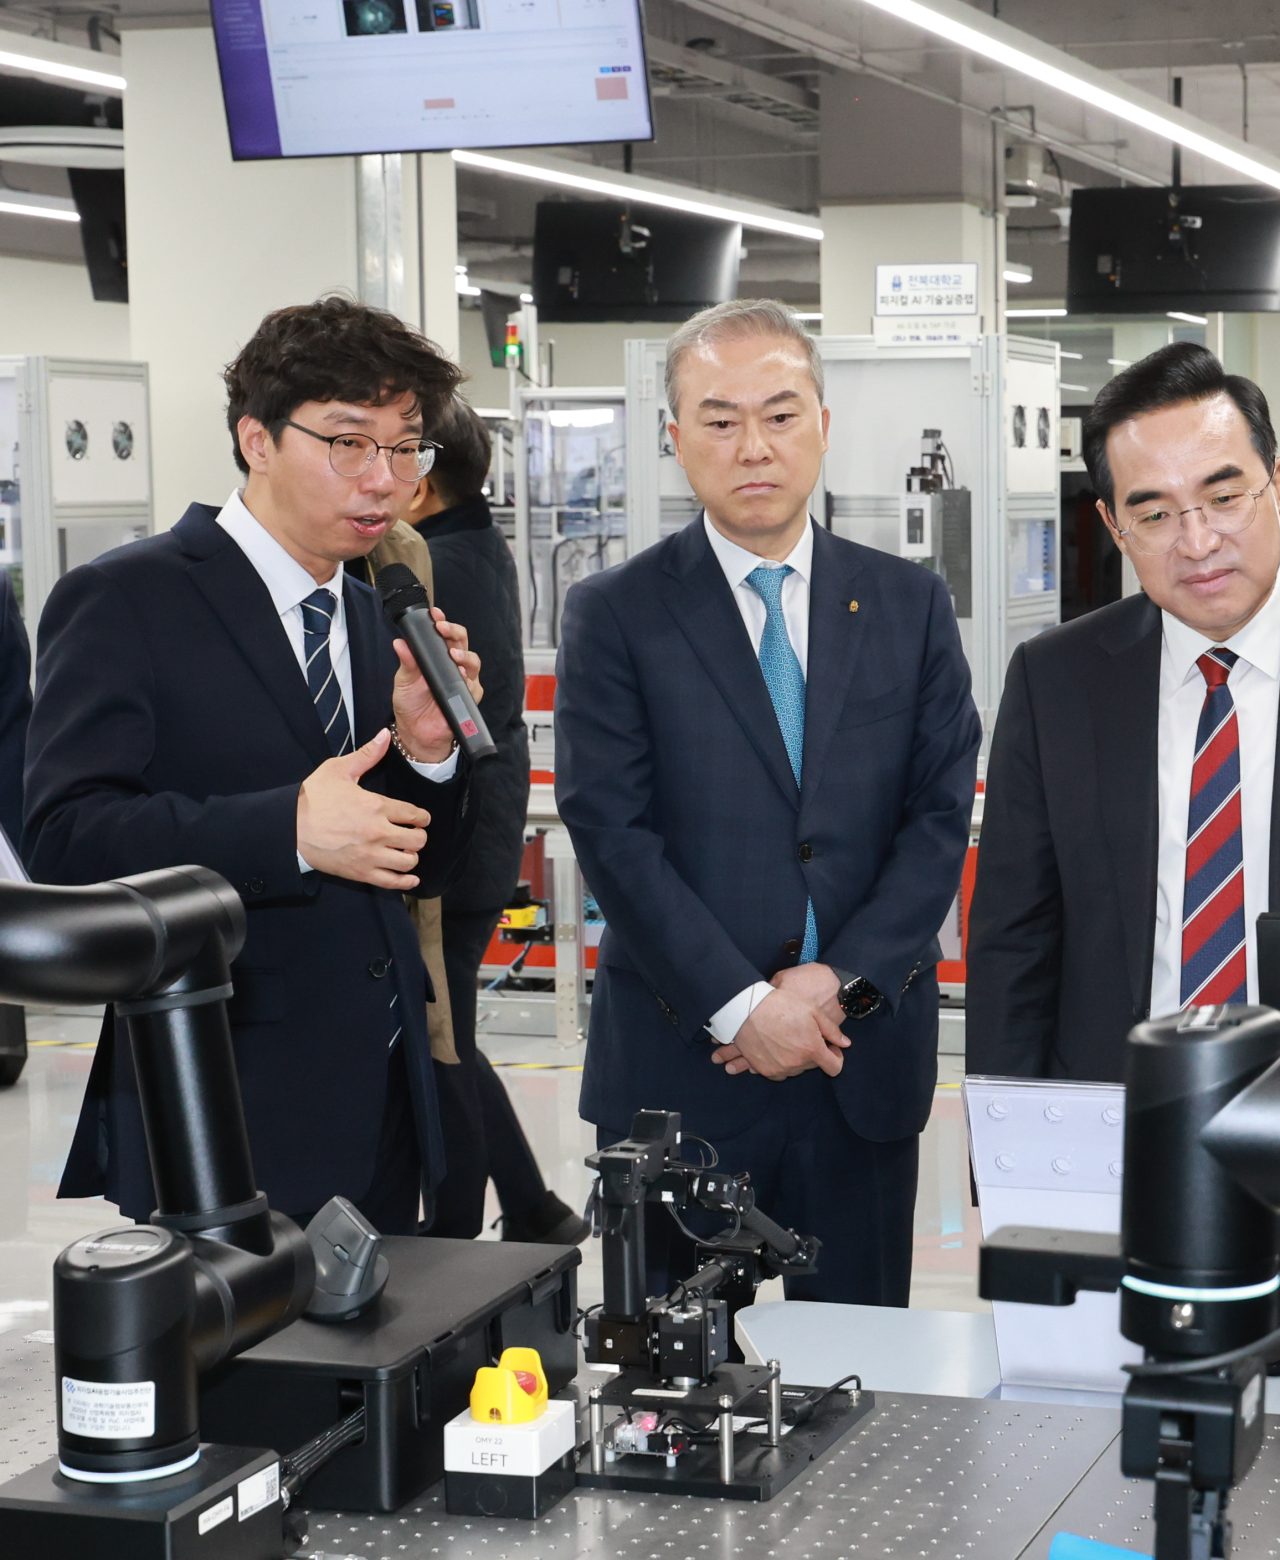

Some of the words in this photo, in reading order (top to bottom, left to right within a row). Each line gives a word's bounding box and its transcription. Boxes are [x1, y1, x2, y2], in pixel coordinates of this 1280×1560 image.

[908, 275, 963, 287] 전북대학교
[879, 295, 909, 306] 피지컬
[911, 295, 922, 305] AI
[925, 294, 975, 306] 기술실증랩
[494, 1437, 503, 1445] 22
[471, 1451, 508, 1467] LEFT
